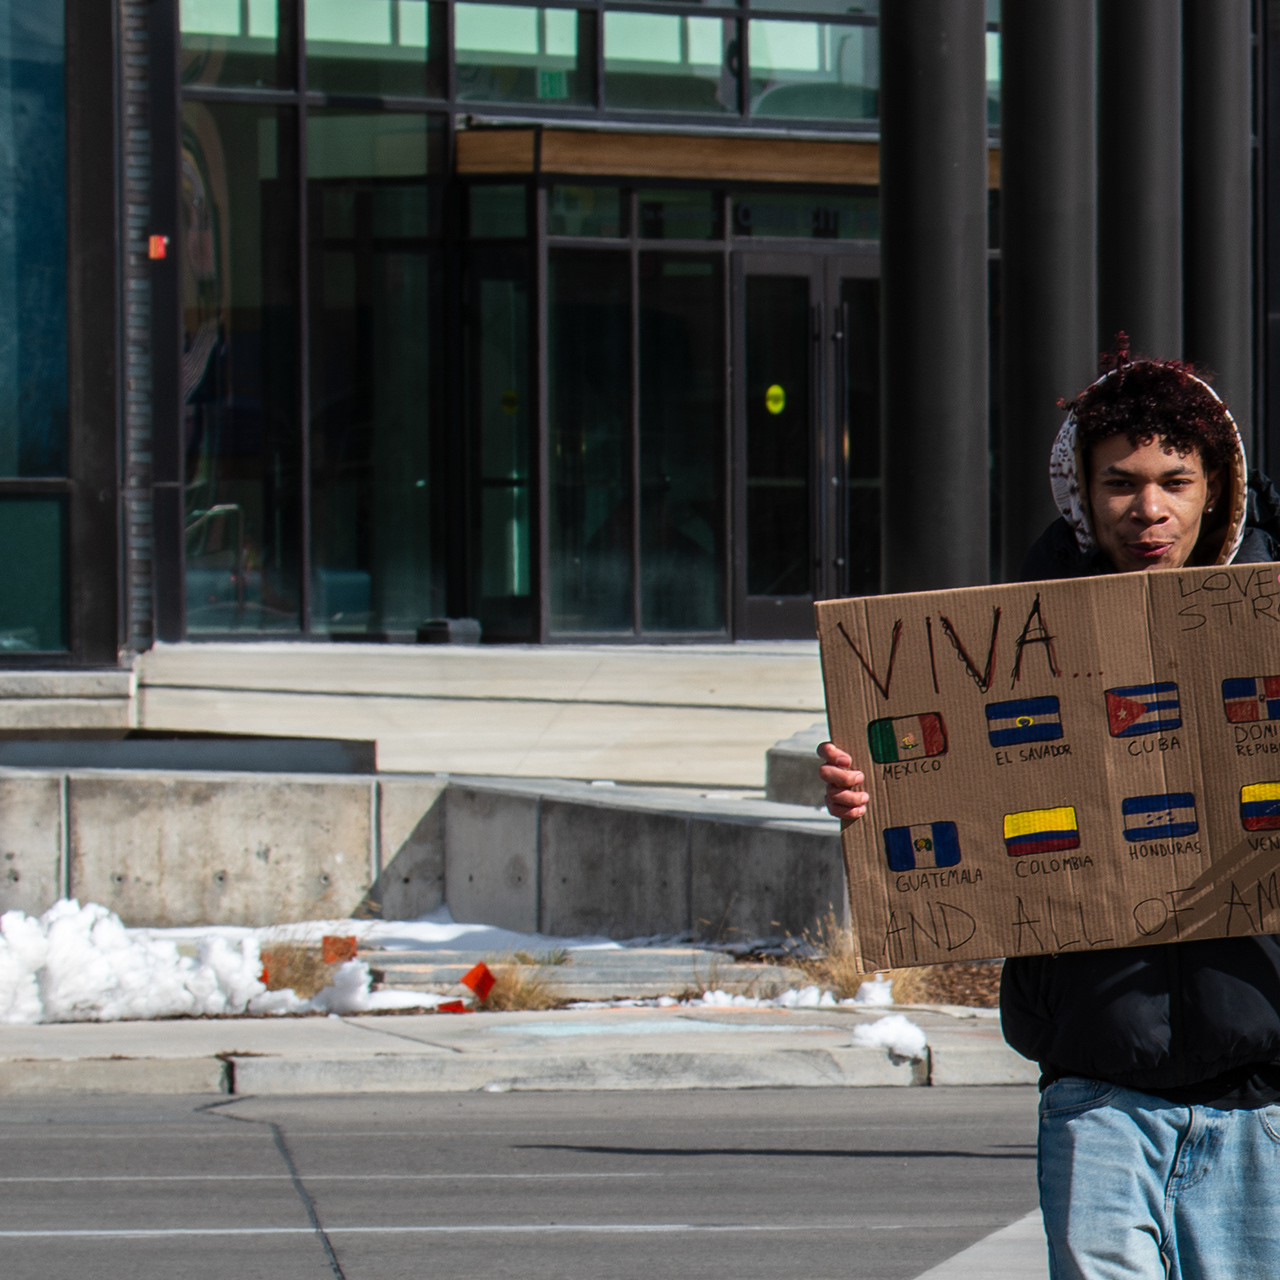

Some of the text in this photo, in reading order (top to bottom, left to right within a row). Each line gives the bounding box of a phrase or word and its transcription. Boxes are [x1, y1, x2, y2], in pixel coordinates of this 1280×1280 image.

[1178, 566, 1279, 598] LOVE
[995, 743, 1073, 766] EL SAVADOR
[1127, 736, 1182, 758] CUBA
[881, 759, 942, 781] MEXICO
[1128, 840, 1203, 861] HONDURAS
[1014, 854, 1095, 878] COLOMBIA
[895, 867, 984, 894] GUATEMALA
[882, 901, 978, 962] AND
[1011, 896, 1115, 953] ALL
[1133, 886, 1197, 938] OF
